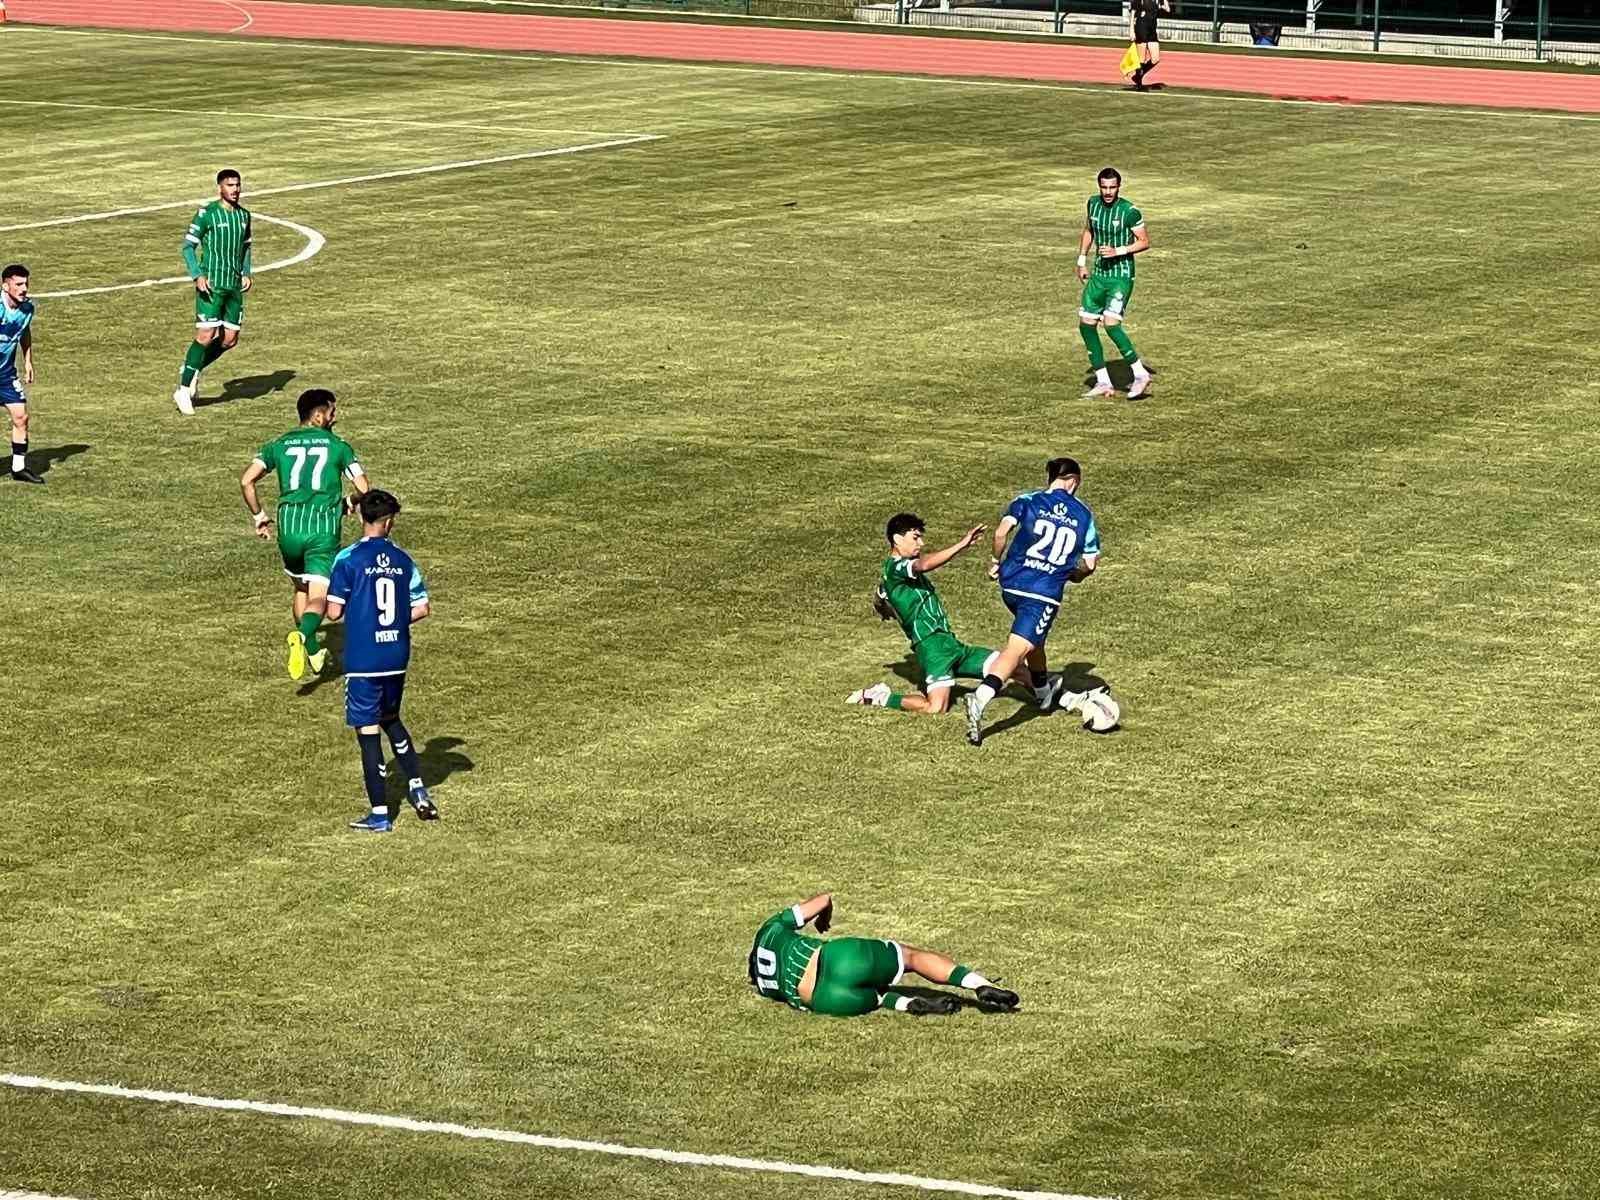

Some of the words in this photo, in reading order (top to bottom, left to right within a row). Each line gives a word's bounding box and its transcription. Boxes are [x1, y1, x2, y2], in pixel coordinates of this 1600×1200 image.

[285, 446, 328, 490] 77
[1026, 519, 1077, 566] 20
[375, 577, 396, 626] 9
